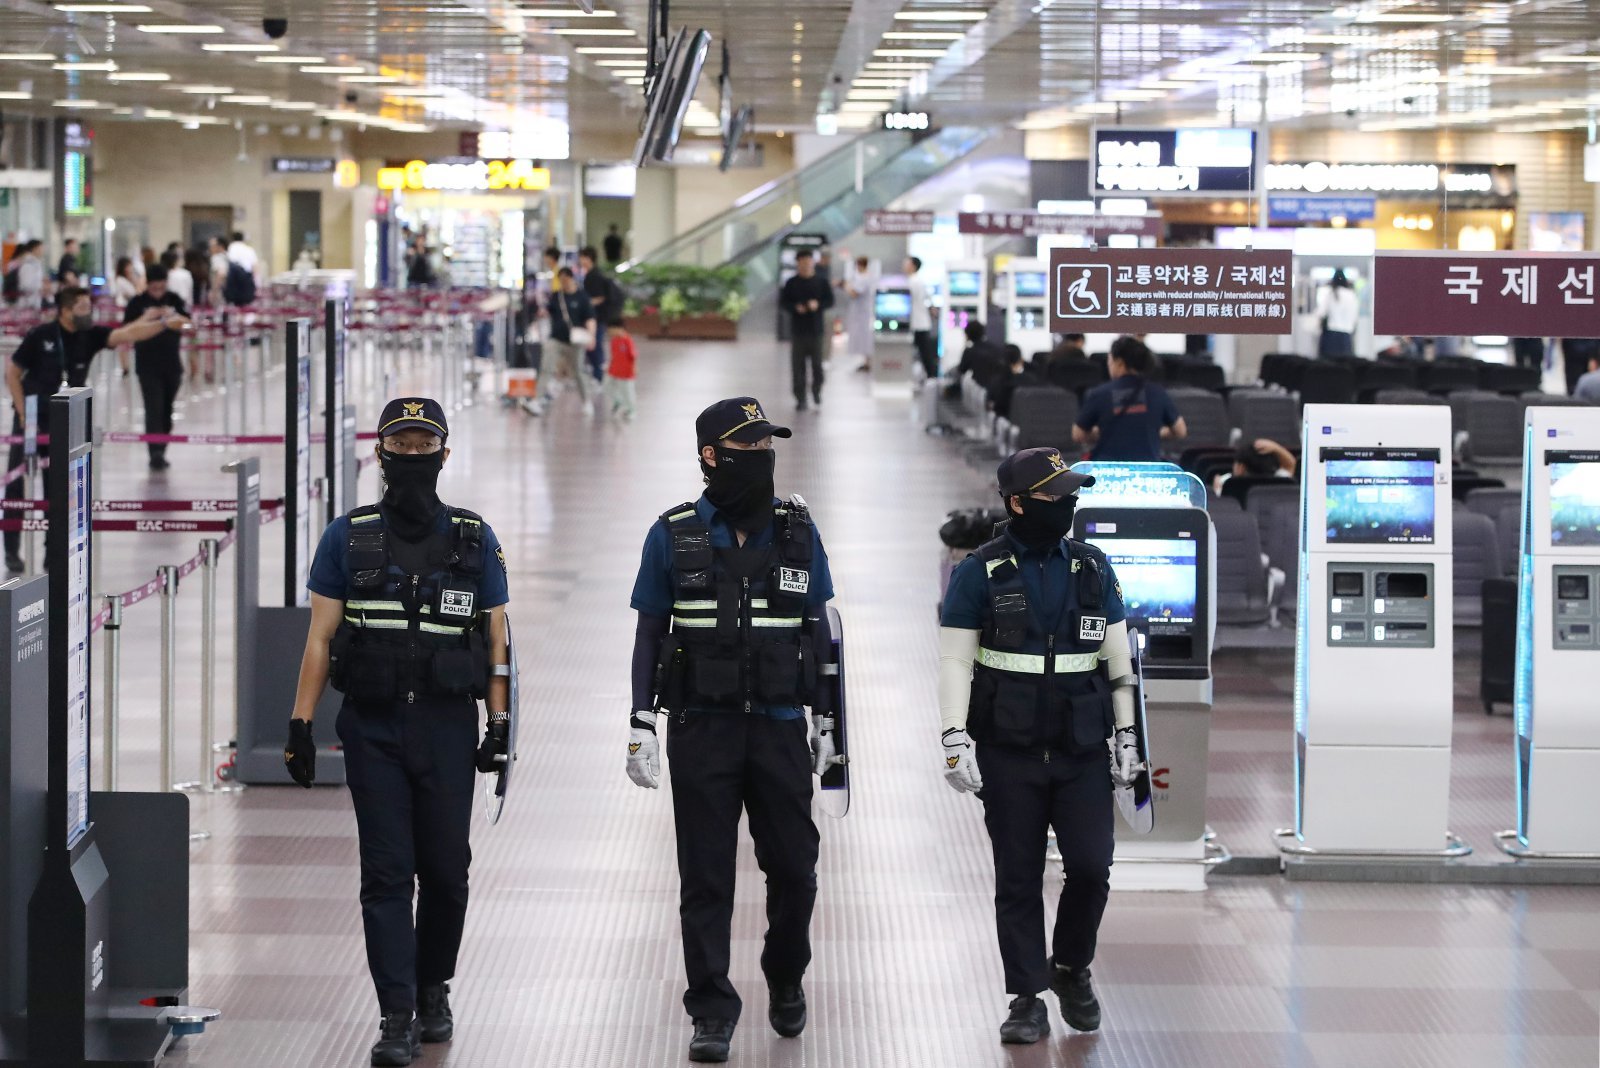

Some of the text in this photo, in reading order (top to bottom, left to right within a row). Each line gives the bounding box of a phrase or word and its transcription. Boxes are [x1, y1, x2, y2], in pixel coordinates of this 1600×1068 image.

[1115, 265, 1286, 287] 교통약자용 / 국제선
[1115, 290, 1152, 301] Passengers
[1153, 290, 1167, 299] with
[1167, 290, 1193, 299] reduced
[1193, 291, 1219, 301] mobility
[1224, 291, 1264, 300] International
[1264, 291, 1286, 302] flights
[92, 501, 109, 511] AC
[136, 520, 163, 531] KAC
